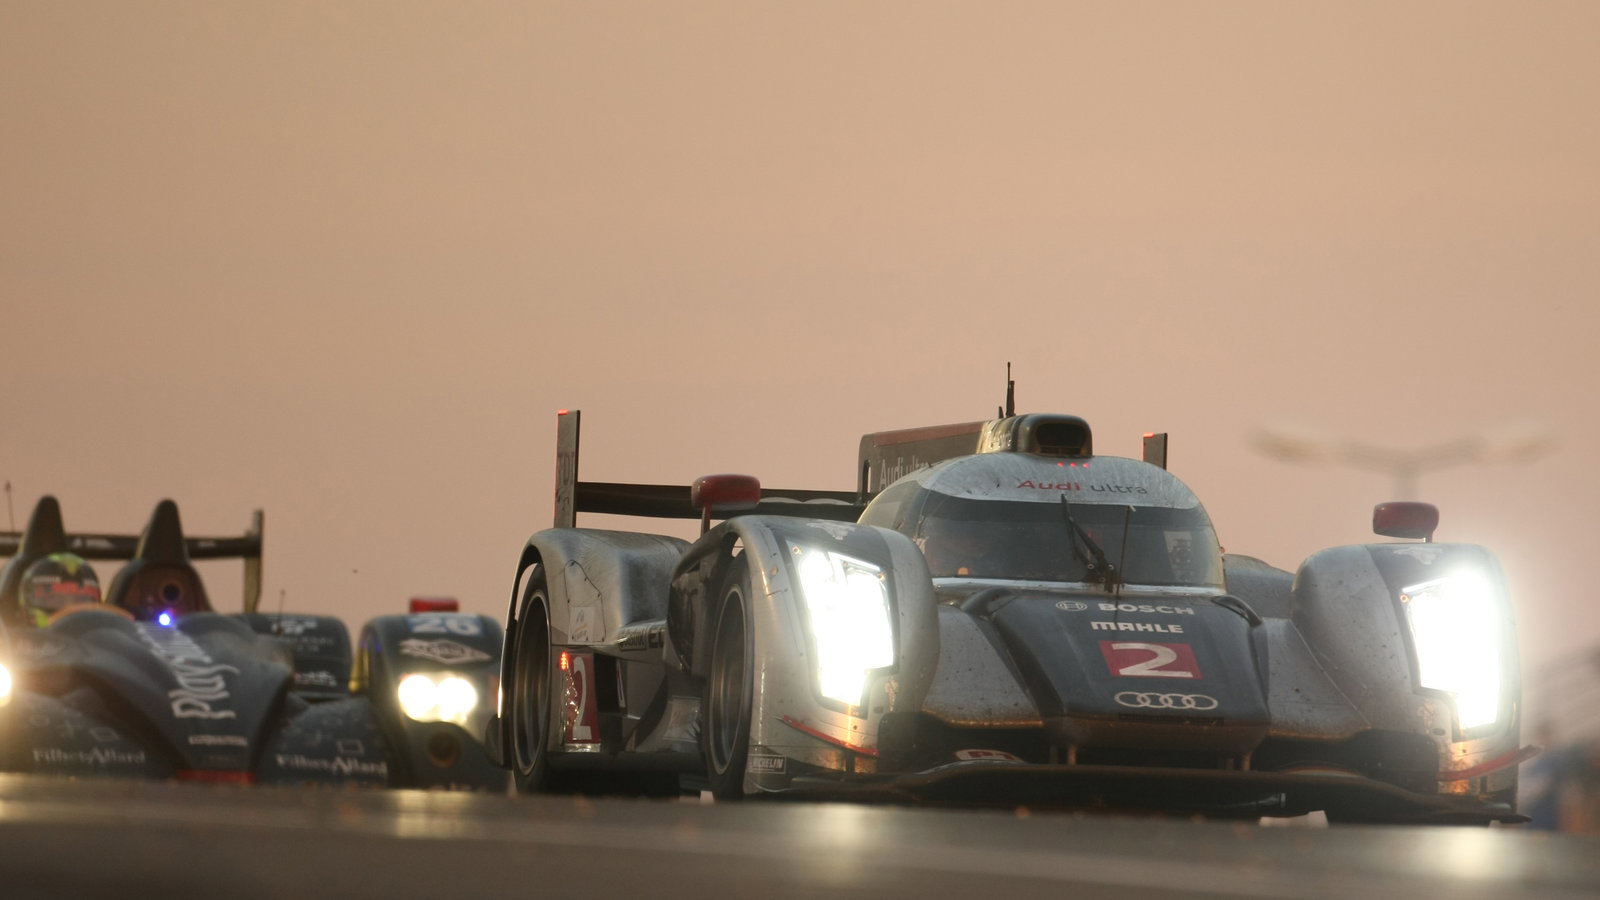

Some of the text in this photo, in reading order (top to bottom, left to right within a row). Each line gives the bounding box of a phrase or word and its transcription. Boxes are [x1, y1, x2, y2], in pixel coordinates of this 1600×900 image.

[1017, 480, 1147, 494] Audi ultra
[1098, 603, 1195, 615] BOSCH
[409, 616, 480, 635] 26
[1090, 621, 1184, 633] MAHLE
[1111, 642, 1193, 678] 2
[572, 656, 592, 740] 2
